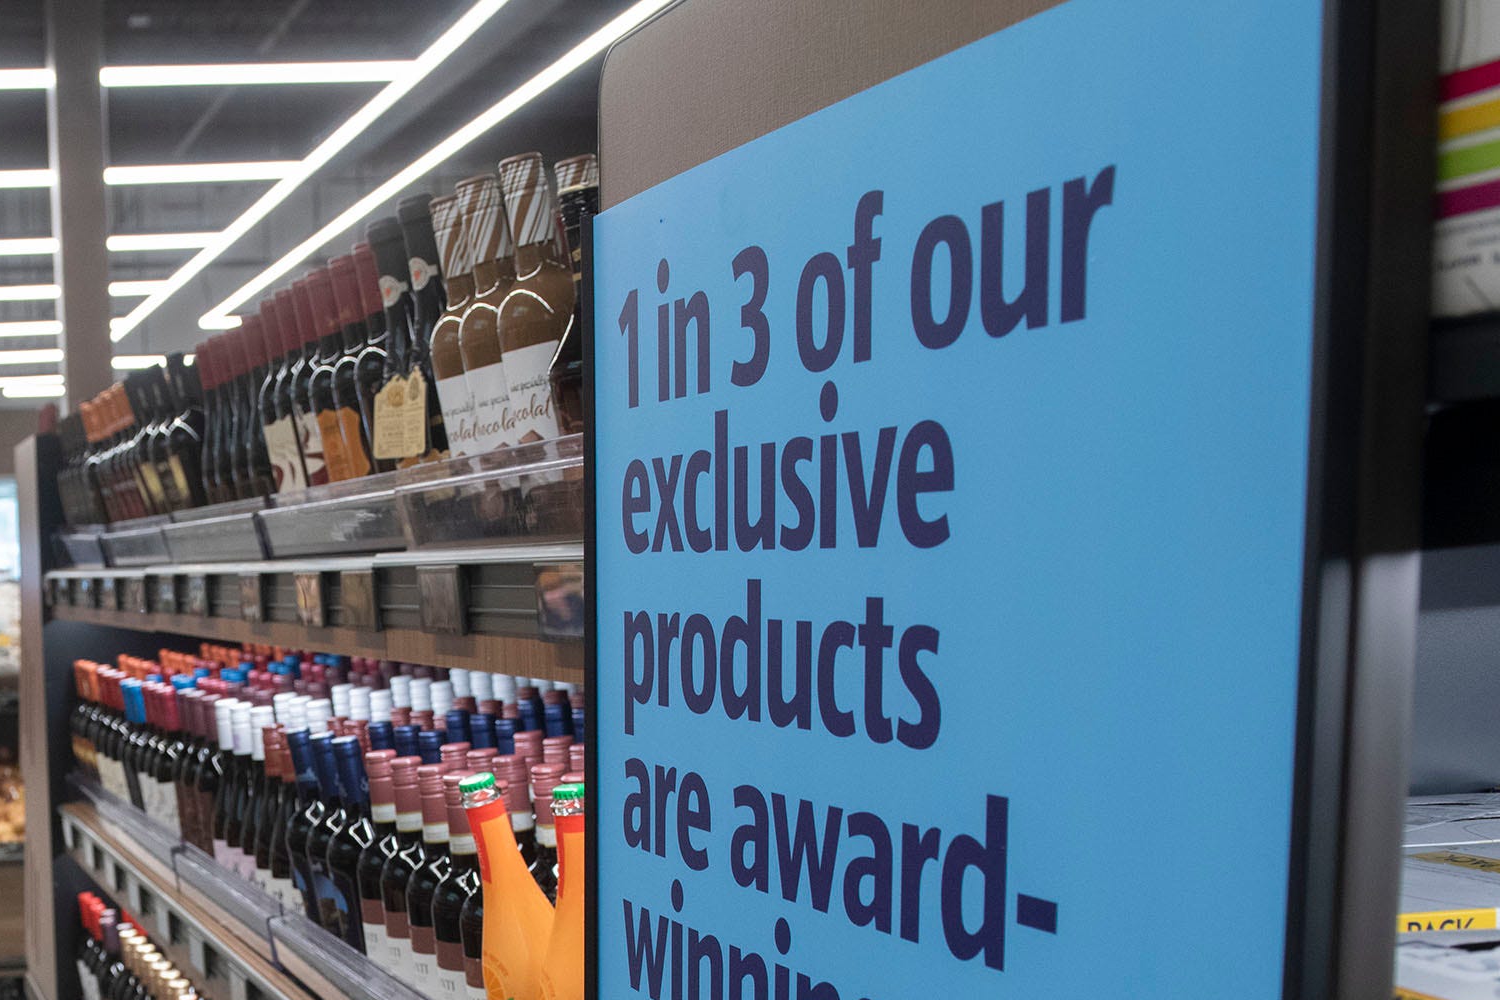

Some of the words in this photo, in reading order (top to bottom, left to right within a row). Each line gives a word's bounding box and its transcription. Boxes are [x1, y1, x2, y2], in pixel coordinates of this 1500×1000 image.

[618, 288, 640, 409] 1
[656, 258, 711, 403] in
[730, 245, 771, 387] 3
[795, 189, 884, 373] of
[910, 164, 1116, 350] our
[622, 380, 955, 555] exclusive
[623, 578, 942, 751] products
[623, 757, 712, 872] are
[730, 793, 1059, 973] award-
